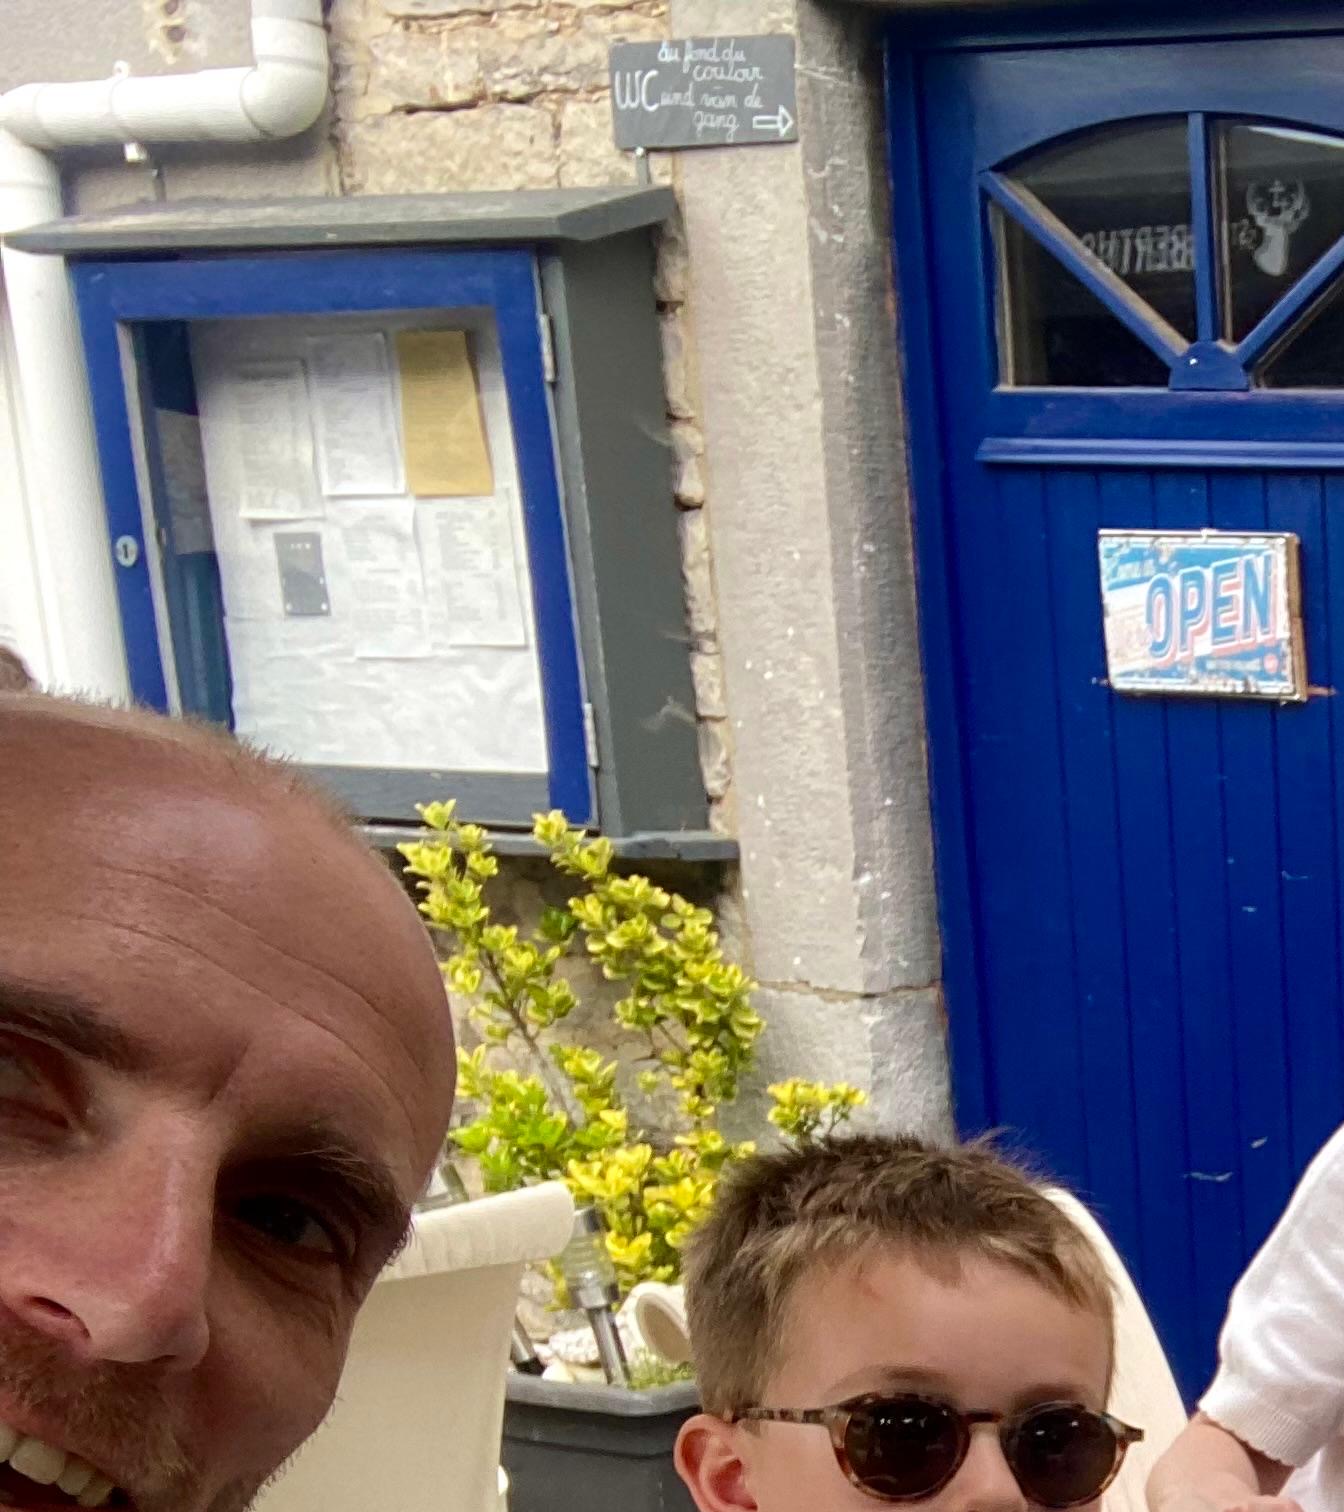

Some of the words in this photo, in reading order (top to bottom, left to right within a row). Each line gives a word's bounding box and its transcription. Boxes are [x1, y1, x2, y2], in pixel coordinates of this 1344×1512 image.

[615, 70, 659, 111] WC
[693, 110, 740, 143] gang
[1145, 550, 1278, 666] OPEN
